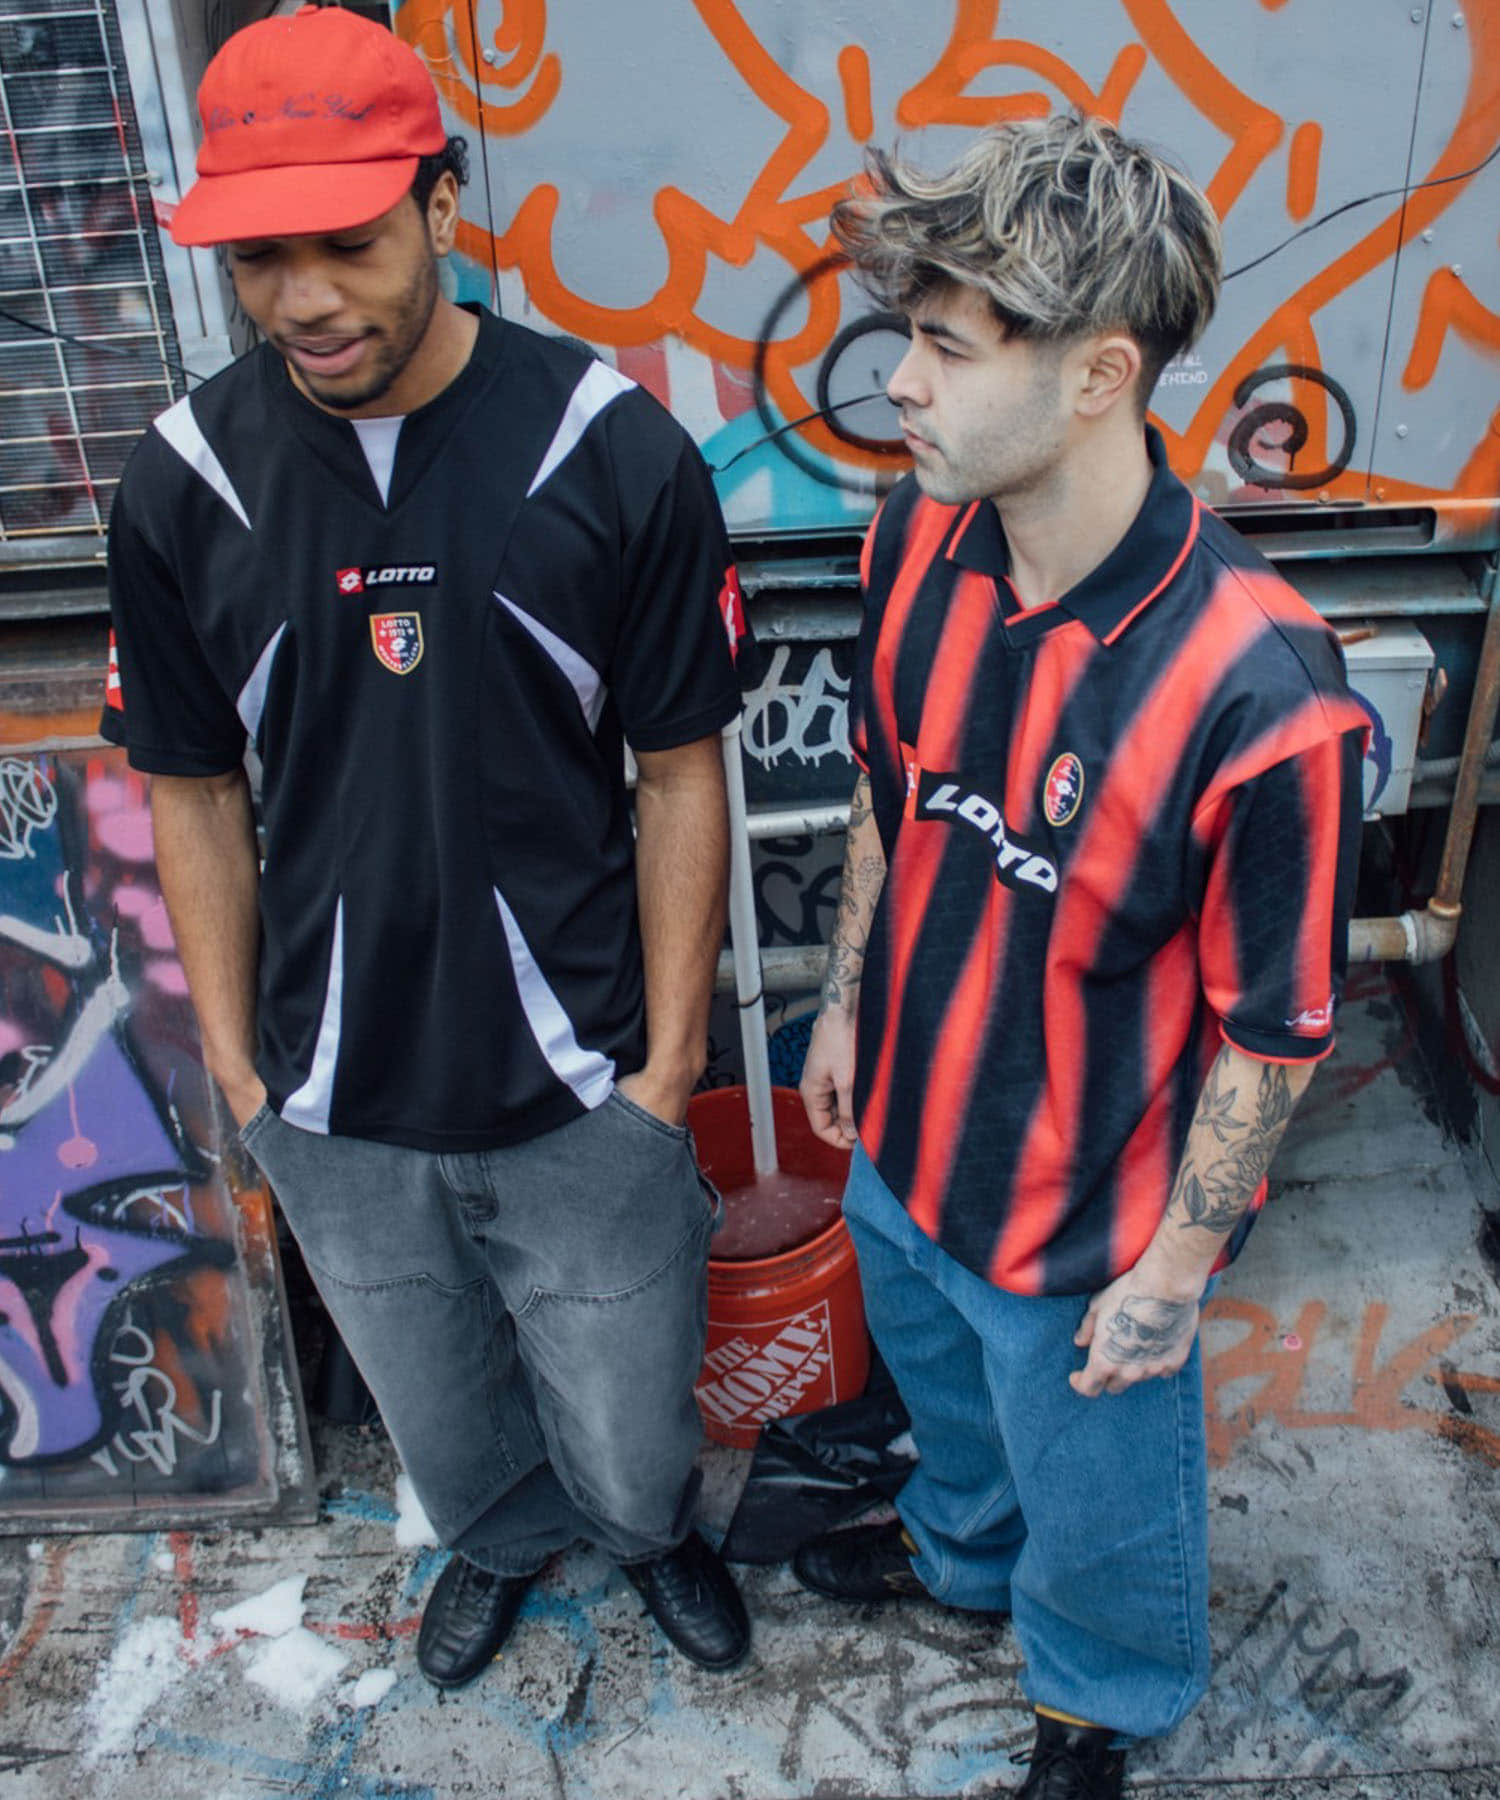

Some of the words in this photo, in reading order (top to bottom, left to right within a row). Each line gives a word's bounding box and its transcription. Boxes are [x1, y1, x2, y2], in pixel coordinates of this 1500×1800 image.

[365, 566, 436, 585] LOTTO
[381, 618, 411, 629] LOTTO
[693, 1312, 829, 1422] HOME
[704, 1335, 760, 1376] THE
[751, 1345, 834, 1422] DEPOT
